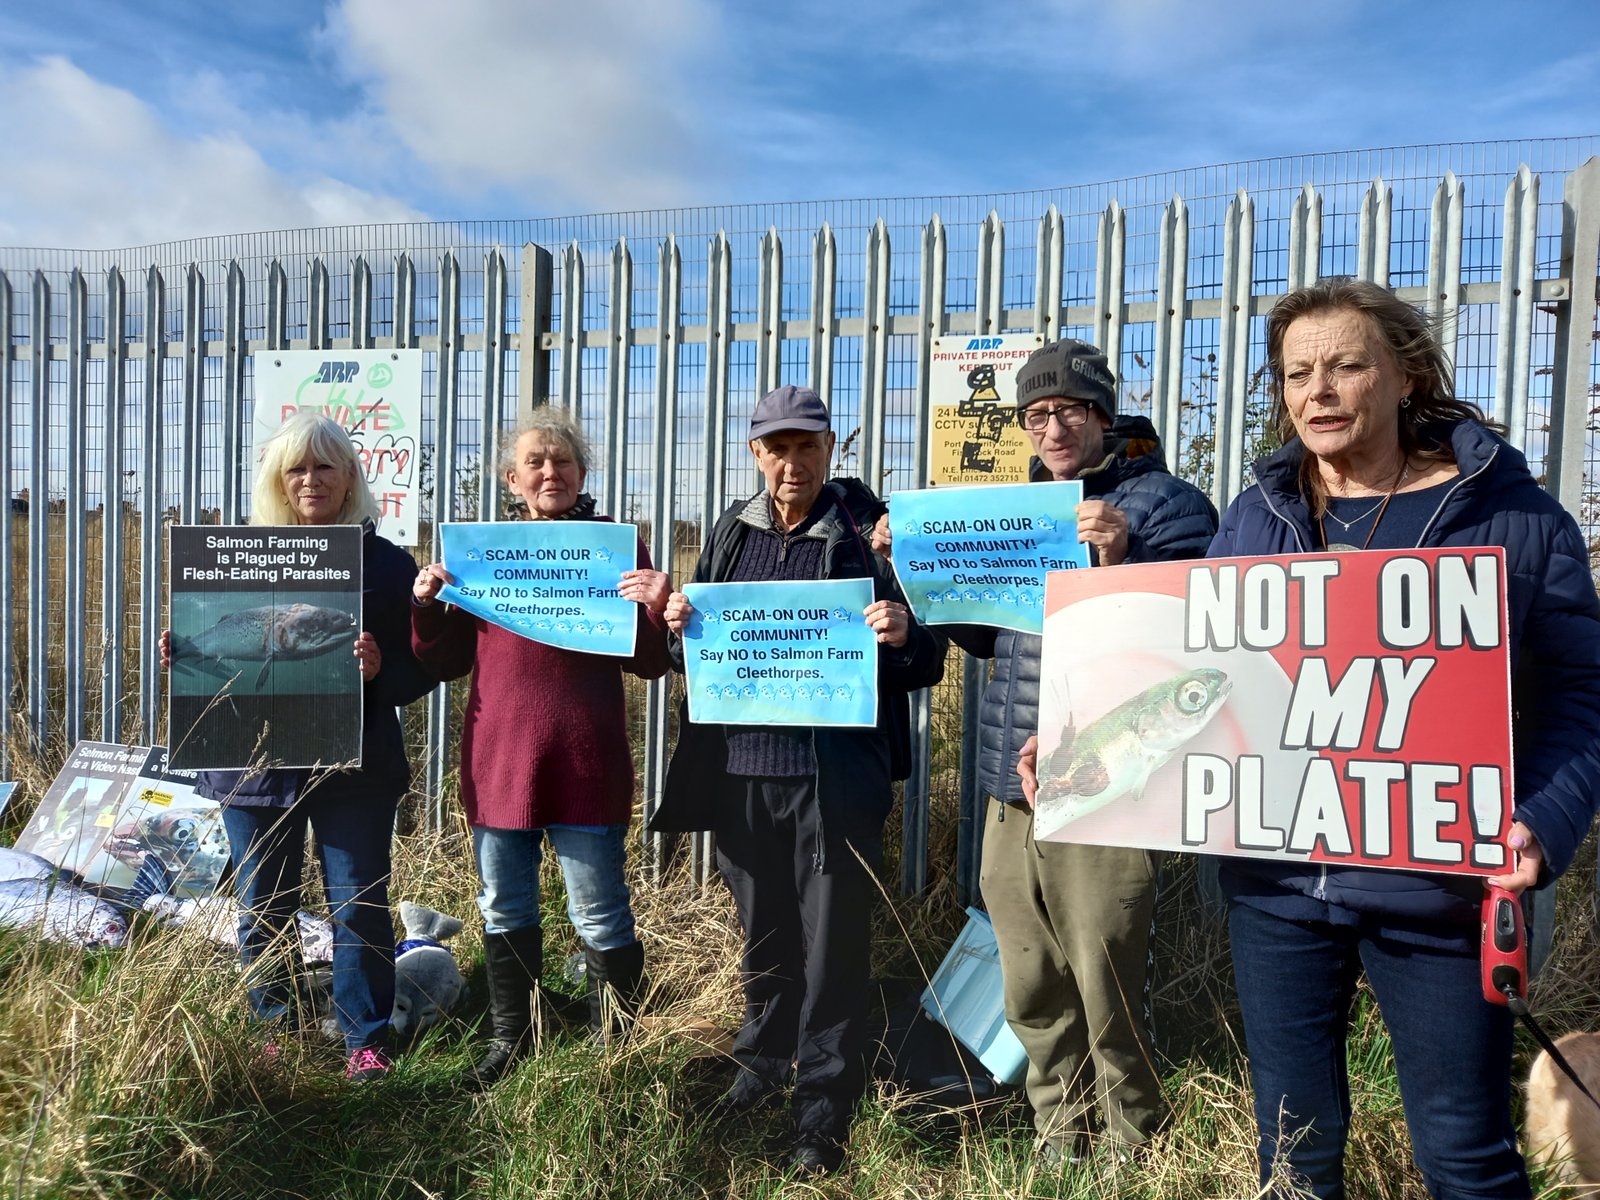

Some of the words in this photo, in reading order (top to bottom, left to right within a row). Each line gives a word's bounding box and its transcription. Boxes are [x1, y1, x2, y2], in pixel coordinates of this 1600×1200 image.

[966, 338, 1003, 350] ABP
[933, 352, 977, 361] PRIVATE
[982, 350, 1032, 359] PROPERT
[314, 362, 359, 383] ABP
[992, 363, 1013, 371] OUT
[937, 408, 950, 417] 24
[935, 420, 965, 429] CCTV
[922, 519, 996, 535] SCAM-ON
[999, 517, 1033, 531] OUR
[206, 536, 263, 549] Salmon
[268, 536, 328, 551] Farming
[935, 539, 1038, 553] COMMUNITY!
[217, 552, 230, 564] is
[235, 552, 295, 567] Plagued
[300, 552, 318, 567] by
[485, 549, 557, 562] SCAM-ON
[560, 549, 591, 561] OUR
[908, 560, 935, 573] Say
[937, 558, 960, 570] NO
[963, 558, 978, 569] to
[981, 557, 1037, 569] Salmon
[1040, 557, 1078, 570] Farm
[183, 567, 278, 582] Flesh-Eating
[282, 567, 351, 580] Parasites
[494, 568, 588, 581] COMMUNITY!
[952, 574, 1043, 588] Cleethorpes.
[459, 586, 486, 600] Say
[489, 587, 511, 599] NO
[515, 588, 528, 598] to
[532, 586, 584, 598] Salmon
[588, 586, 623, 598] Farm
[1184, 559, 1341, 652] NOT
[1377, 554, 1502, 651] ON
[494, 603, 585, 618] Cleethorpes.
[722, 609, 794, 622] SCAM-ON
[797, 609, 829, 621] OUR
[730, 628, 828, 642] COMMUNITY!
[700, 649, 724, 663] Say
[727, 648, 749, 661] NO
[752, 649, 767, 660] to
[771, 647, 823, 660] Salmon
[827, 648, 864, 660] Farm
[736, 666, 824, 682] Cleethorpes.
[1280, 656, 1438, 753] MY
[78, 747, 114, 760] Salmon
[114, 751, 147, 764] Farmin
[72, 759, 82, 769] is
[81, 761, 88, 770] a
[90, 760, 117, 773] Video
[151, 764, 158, 772] a
[1181, 752, 1506, 868] PLATE!
